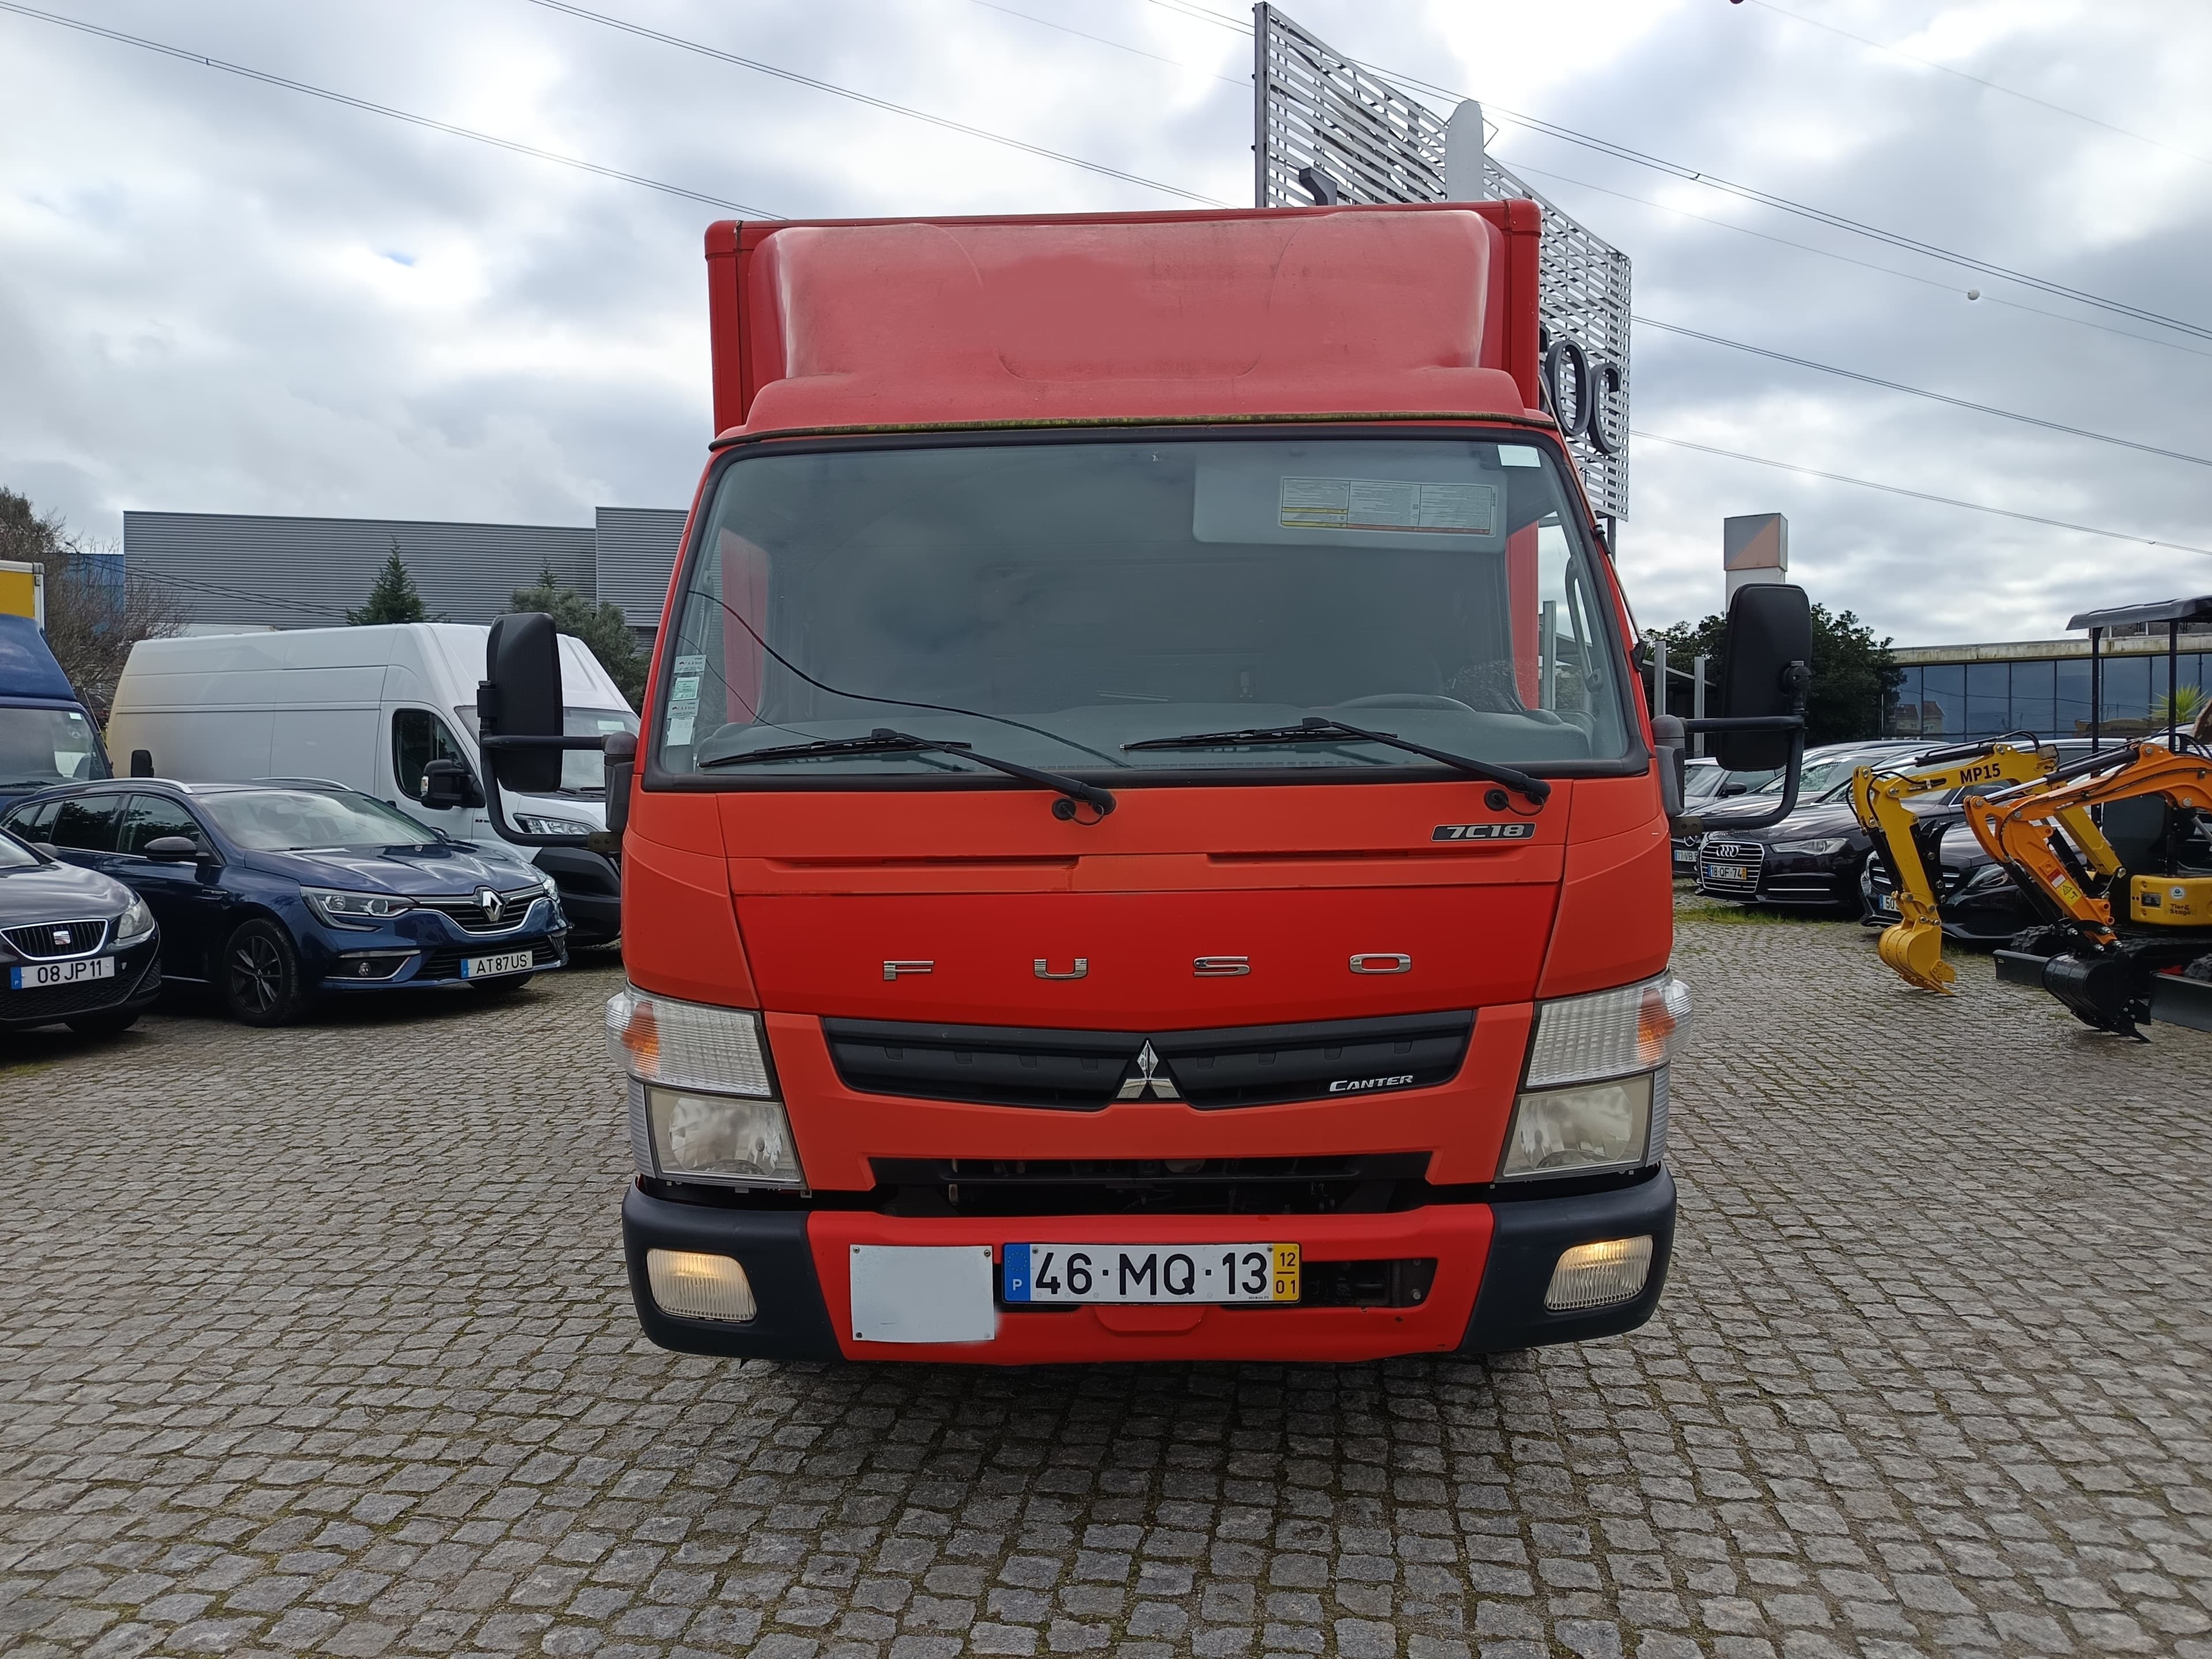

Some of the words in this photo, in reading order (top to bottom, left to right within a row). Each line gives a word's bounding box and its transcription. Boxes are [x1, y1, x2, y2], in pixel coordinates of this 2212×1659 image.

[1960, 763, 2001, 784] MP15
[1447, 825, 1525, 838] 7C18
[883, 953, 1412, 980] FUSO
[1330, 1075, 1413, 1092] CANTER
[1280, 1252, 1296, 1267] 12
[1013, 1278, 1022, 1290] P
